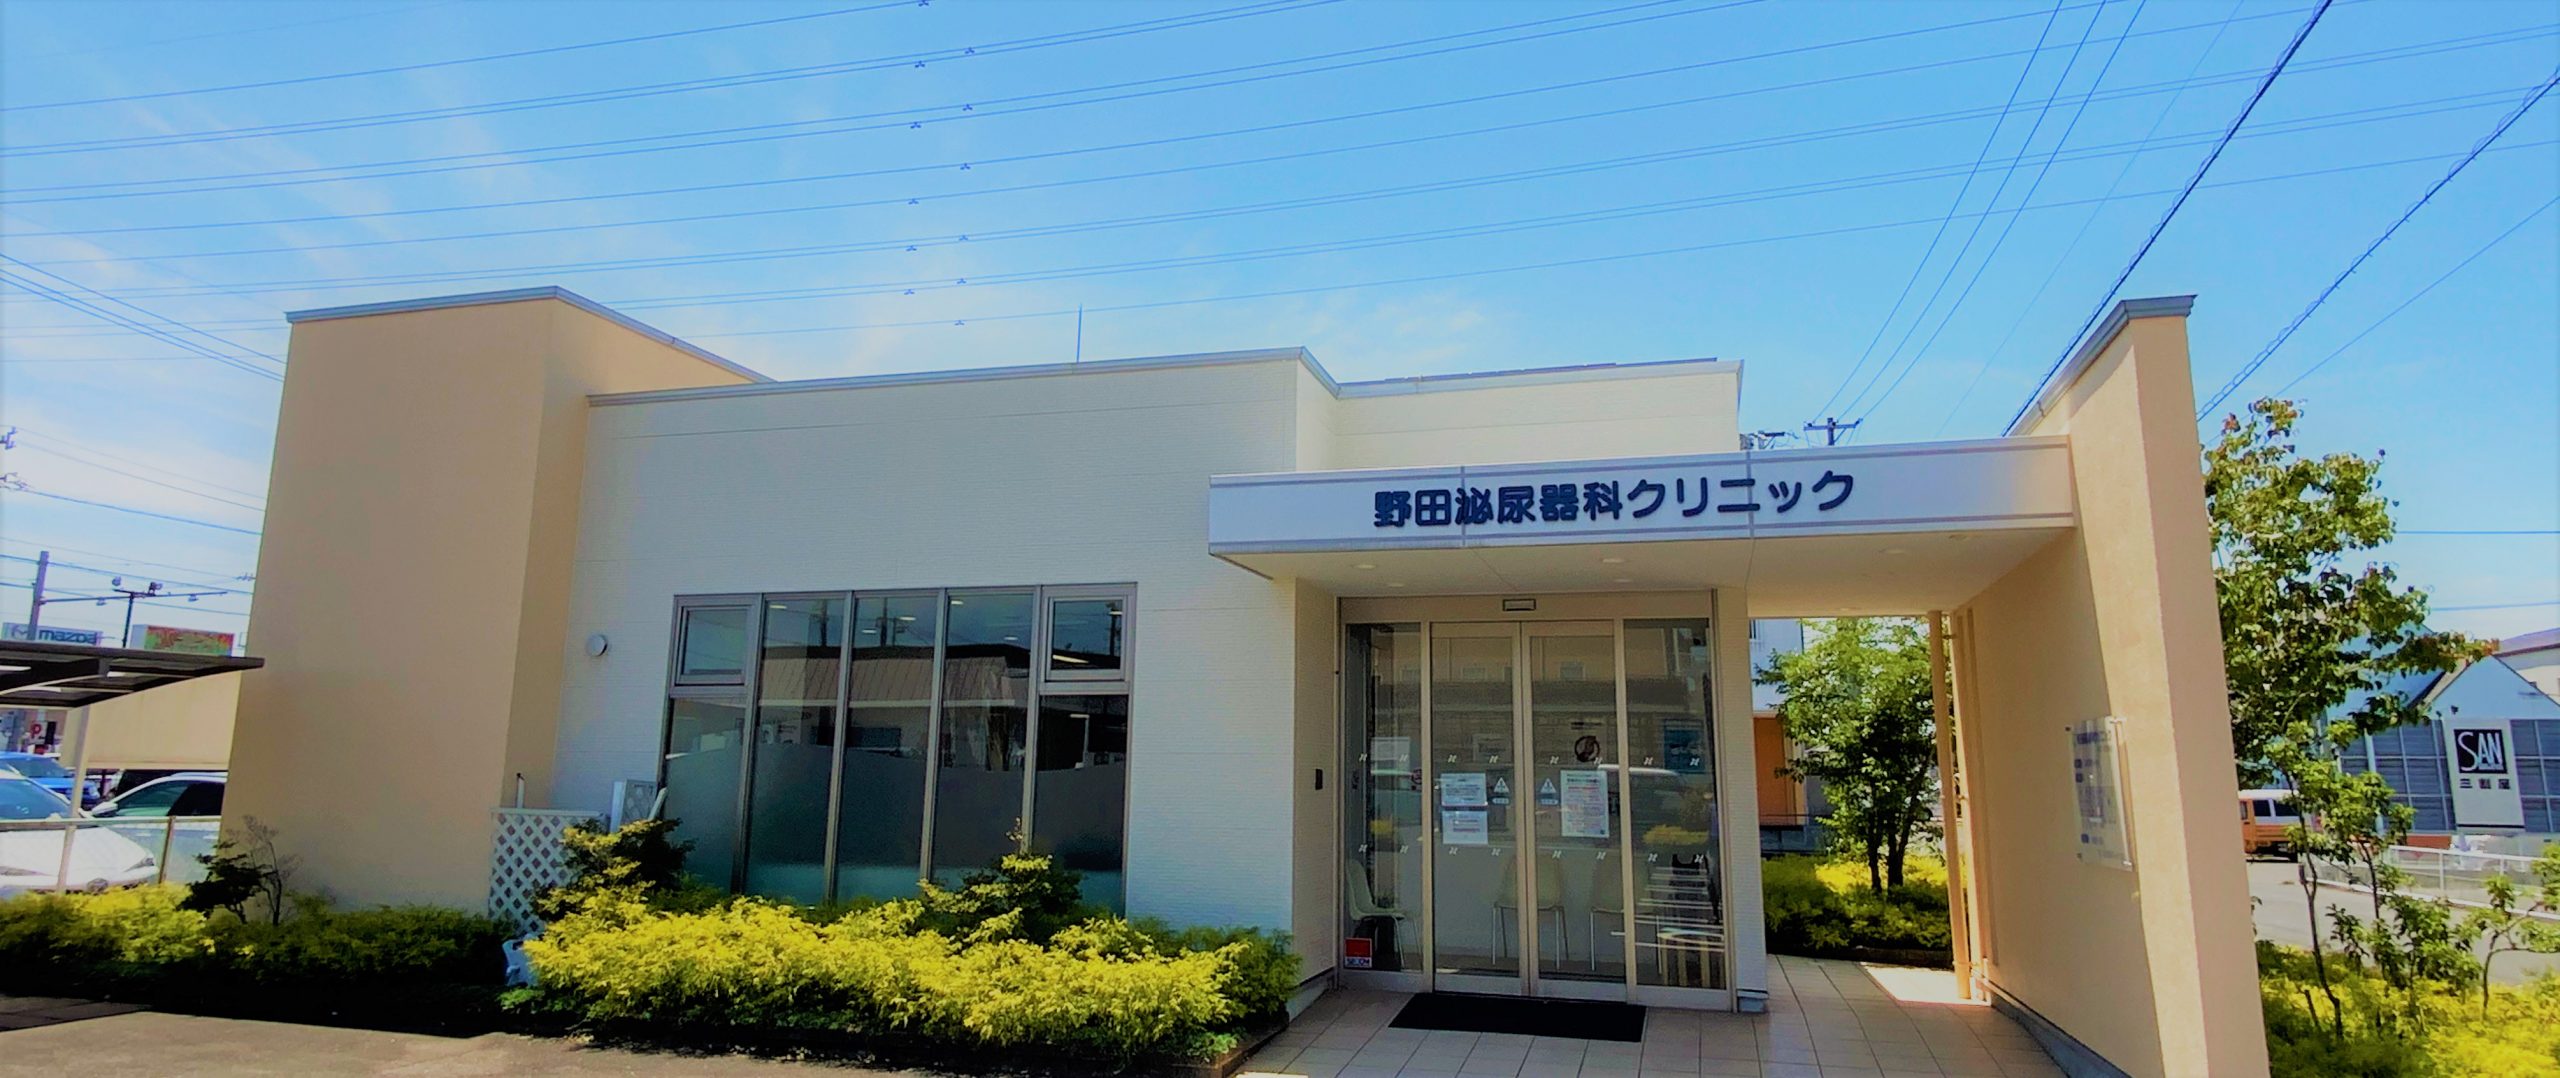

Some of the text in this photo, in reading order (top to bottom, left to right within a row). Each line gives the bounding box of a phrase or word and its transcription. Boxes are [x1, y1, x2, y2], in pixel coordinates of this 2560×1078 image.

[1373, 469, 1855, 528] 野田泌尿器科クリニック
[39, 630, 98, 646] mazda
[2457, 731, 2504, 772] SAN
